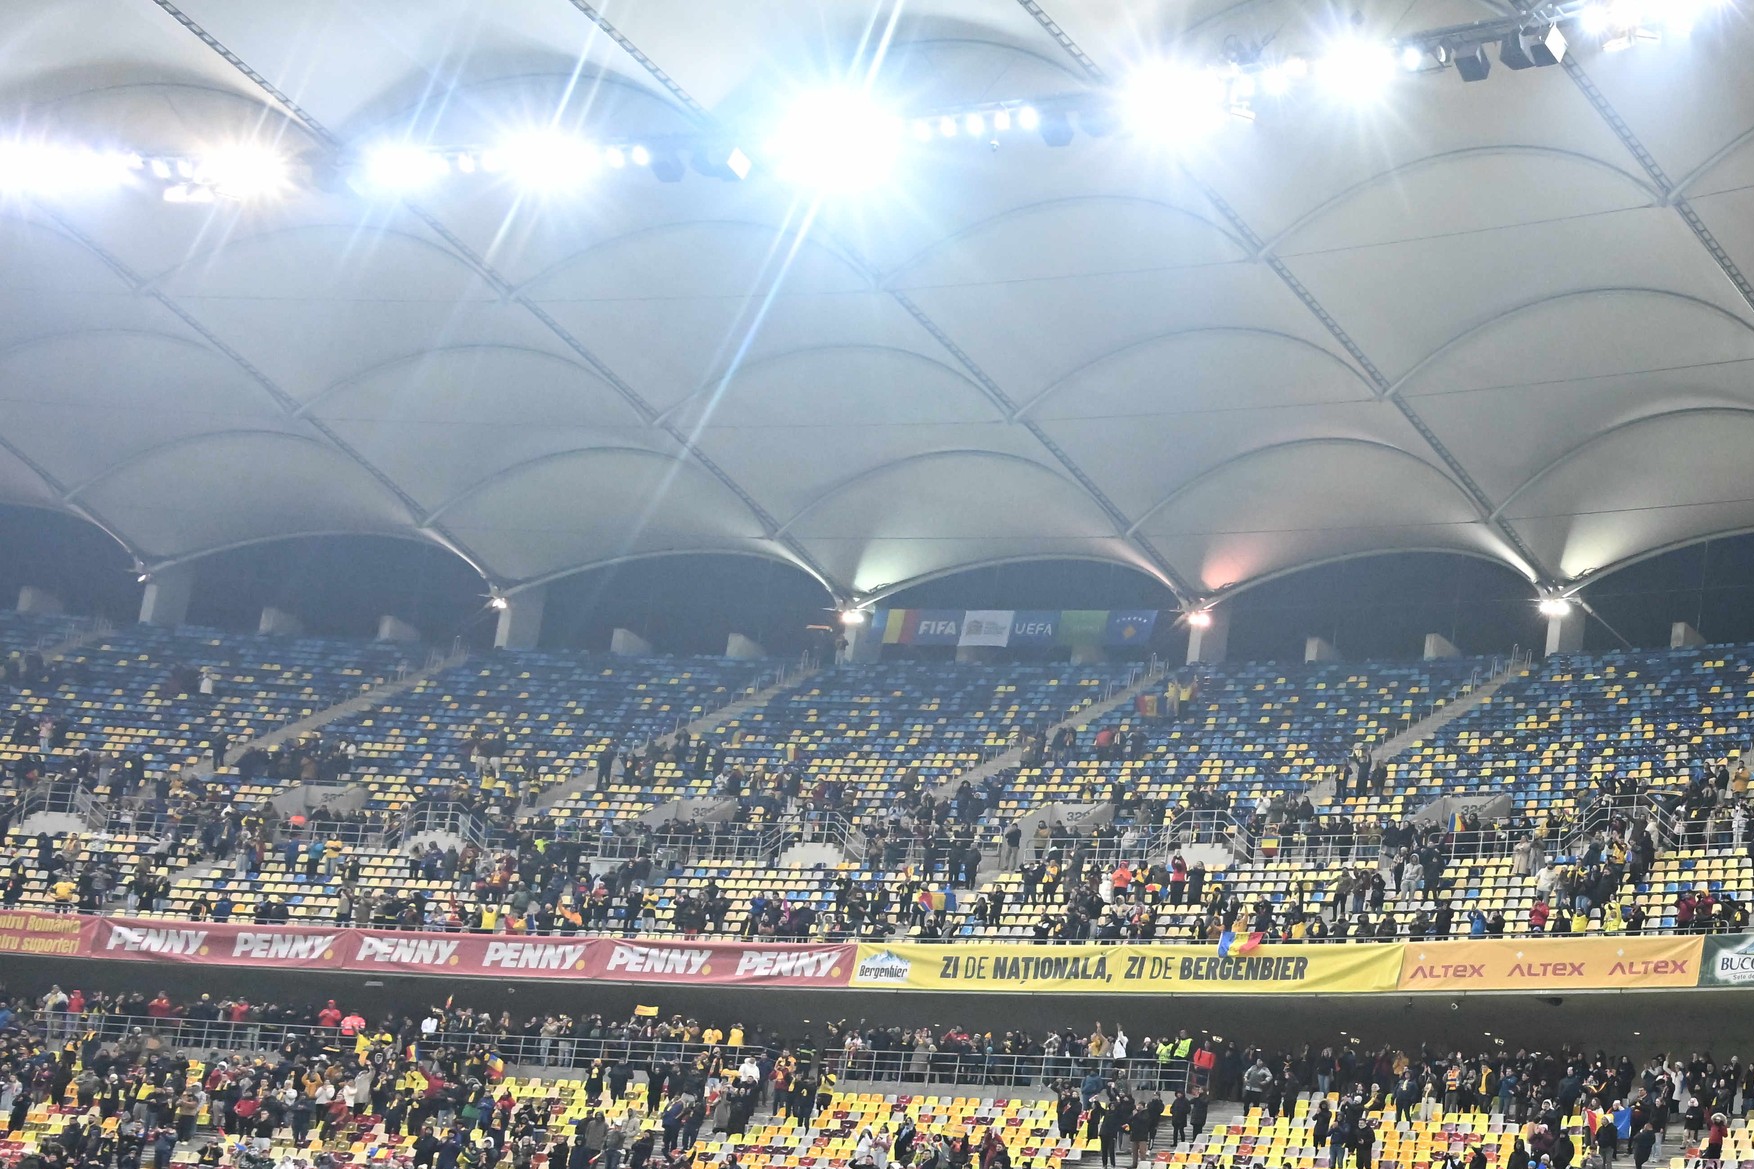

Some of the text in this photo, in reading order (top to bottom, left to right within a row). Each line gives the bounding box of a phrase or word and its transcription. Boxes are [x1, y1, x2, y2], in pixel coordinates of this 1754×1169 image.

[918, 620, 957, 636] FIFA
[1015, 623, 1051, 636] UEFA
[21, 937, 81, 955] suporteri
[858, 963, 909, 980] Bergenbier
[940, 956, 960, 980] ZI
[963, 956, 989, 980] DE
[1124, 956, 1146, 980] ZI
[1150, 956, 1174, 980] DE
[1179, 956, 1309, 981] BERGENBIER
